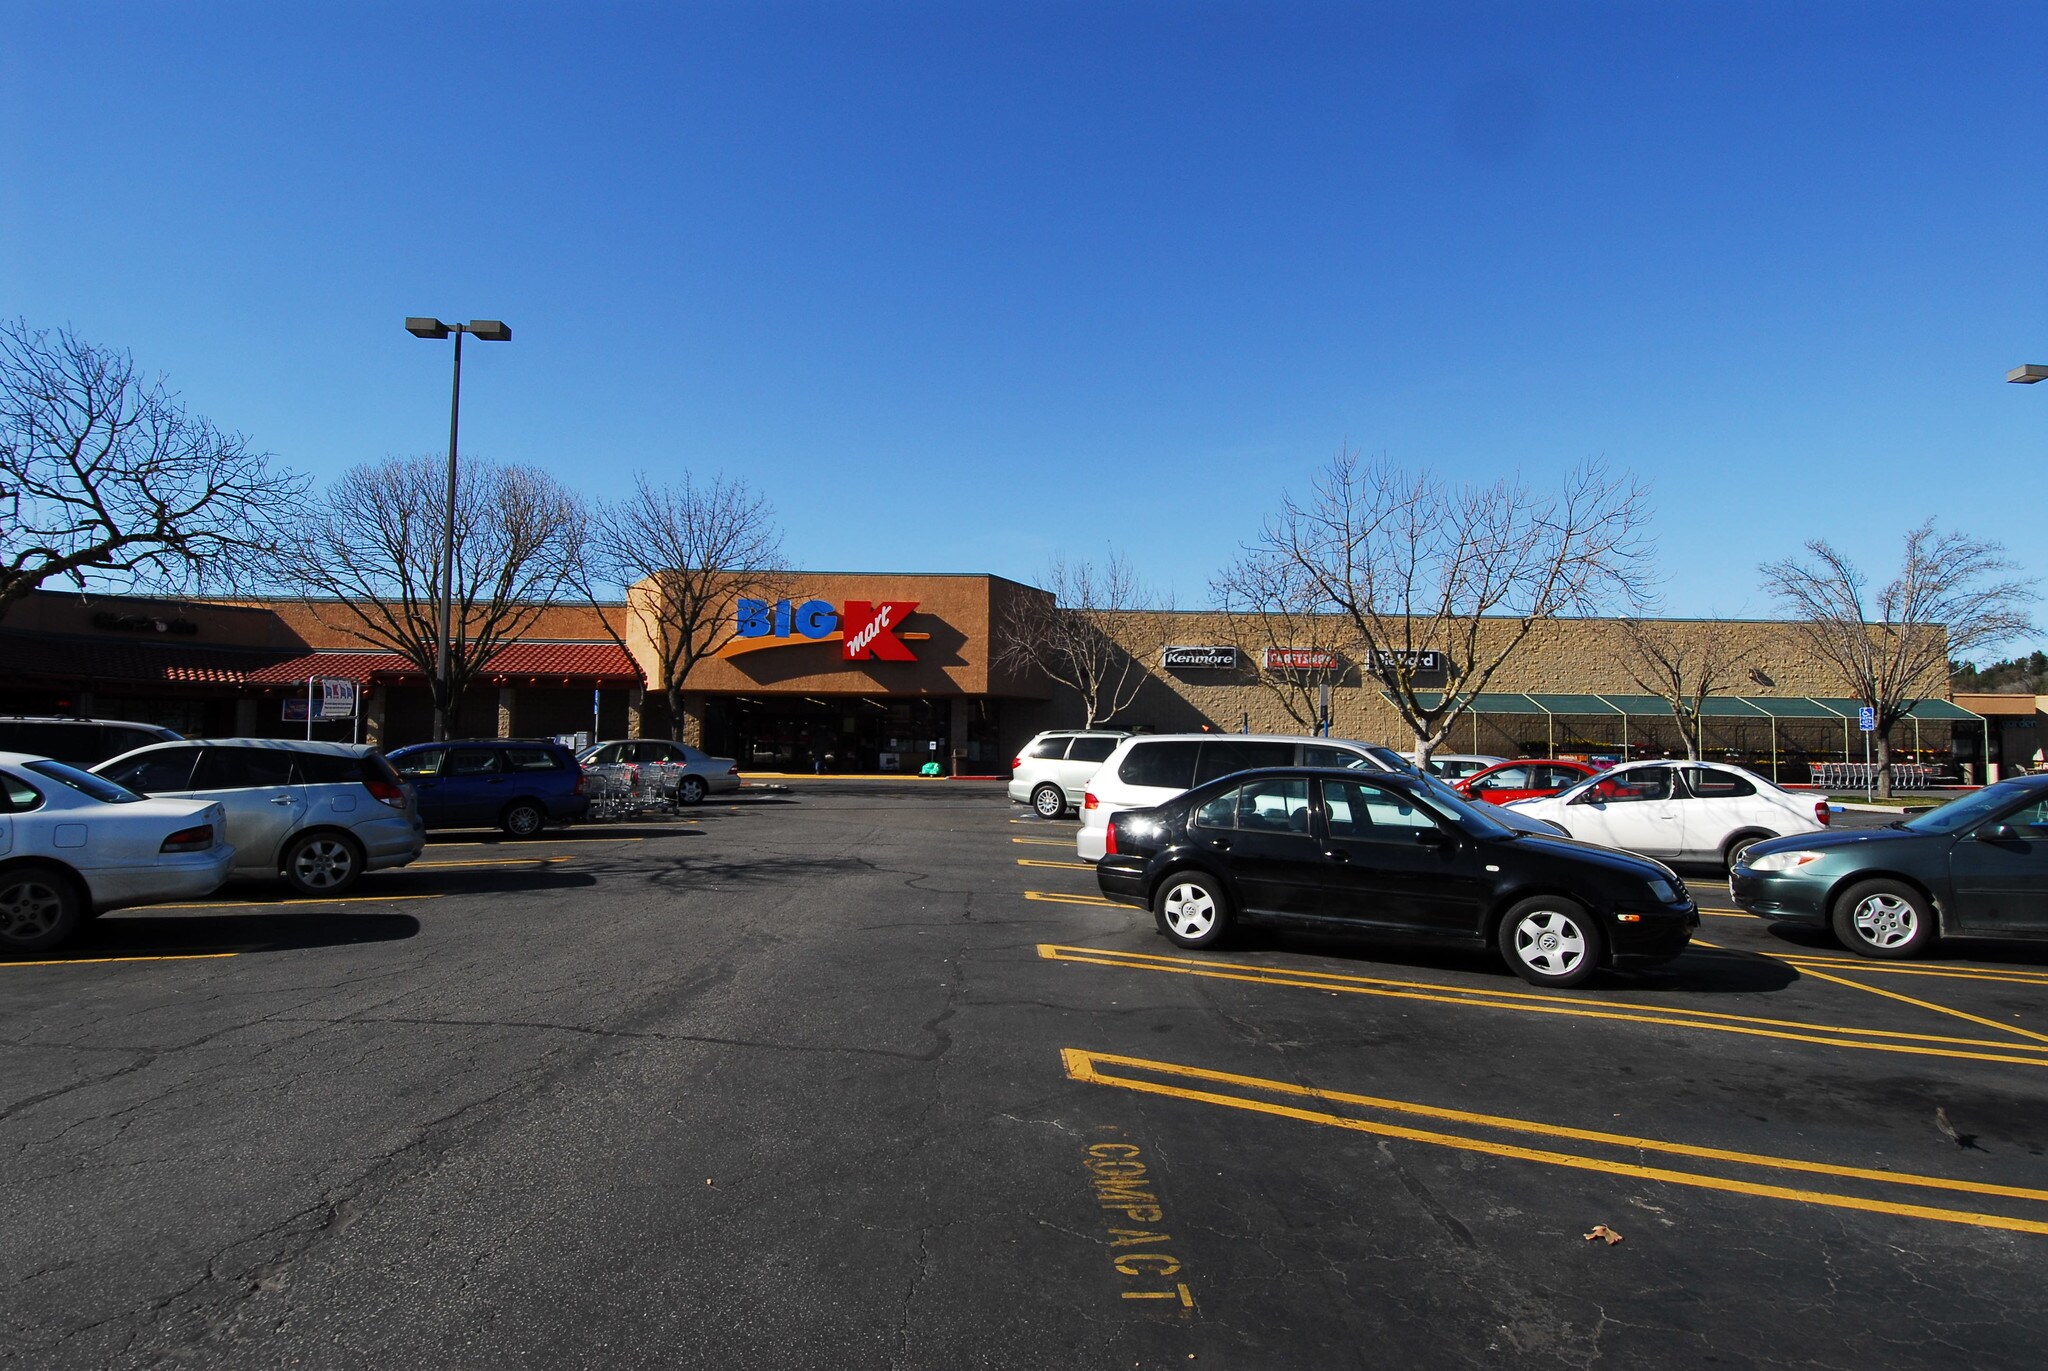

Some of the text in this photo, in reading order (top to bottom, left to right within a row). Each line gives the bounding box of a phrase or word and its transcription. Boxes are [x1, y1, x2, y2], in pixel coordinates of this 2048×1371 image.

[737, 598, 920, 661] BIG K
[846, 605, 892, 656] mart
[1167, 653, 1233, 664] Kenmore
[1088, 1143, 1194, 1308] COMPACT
